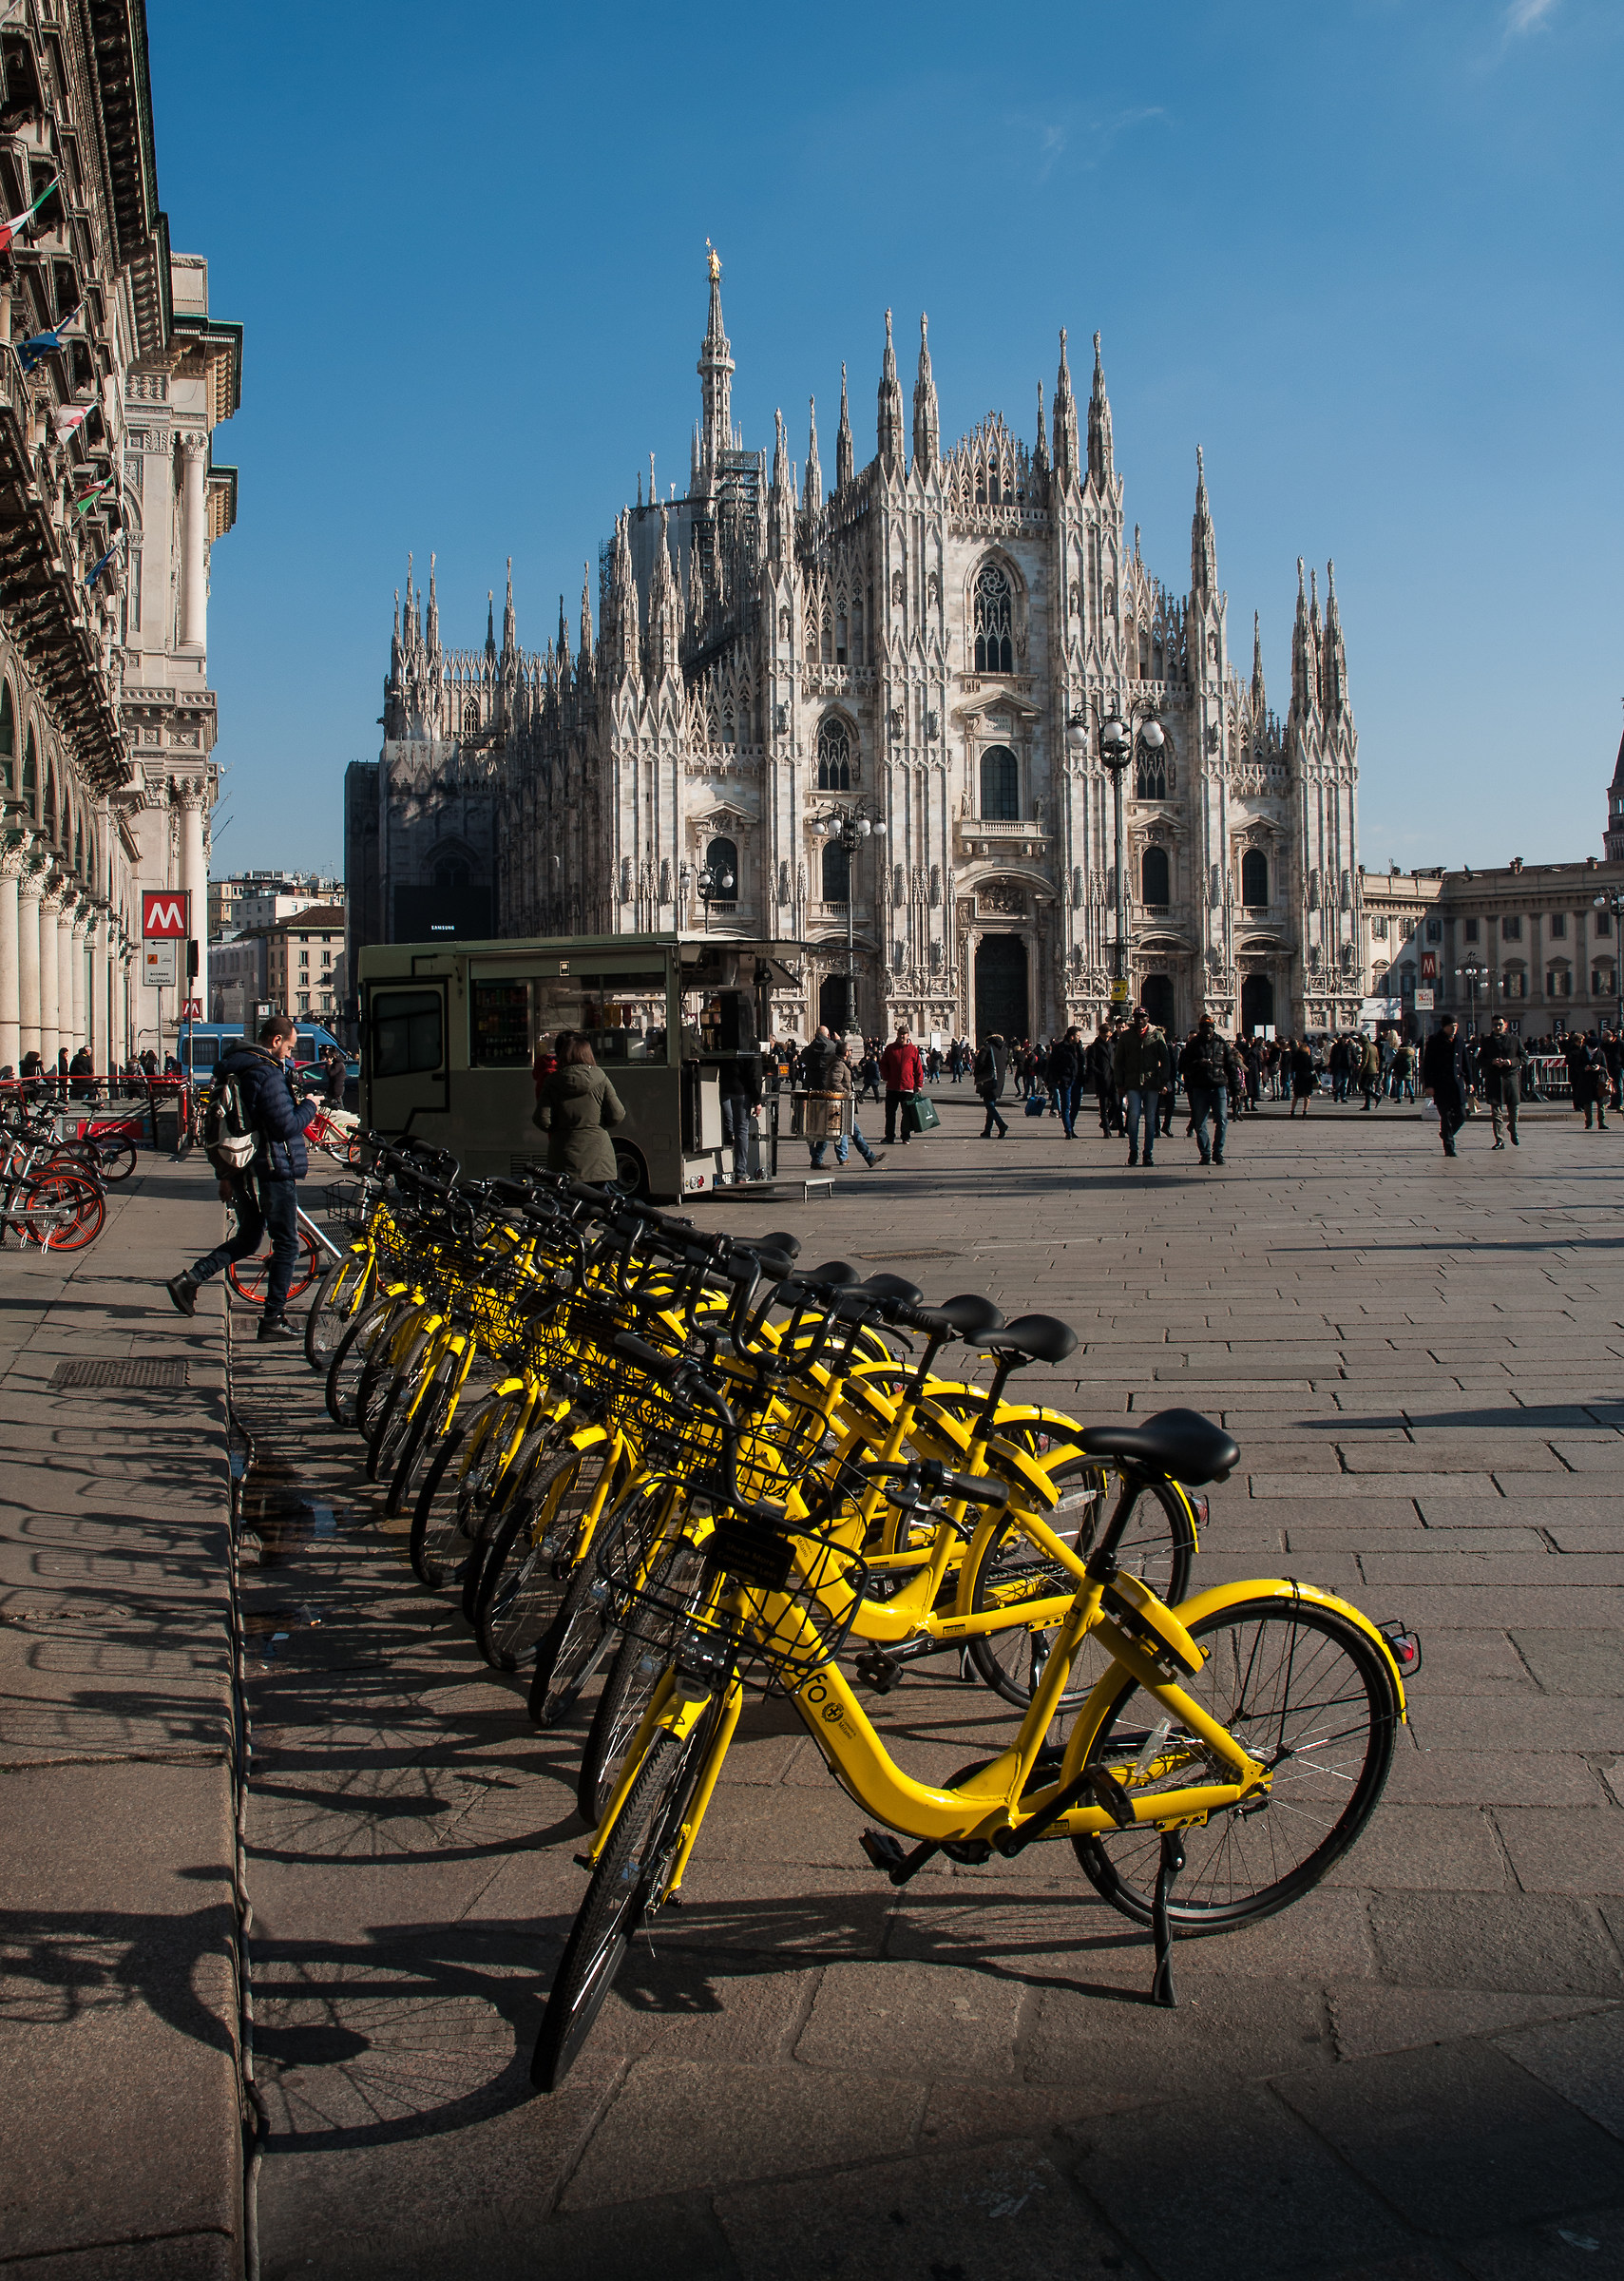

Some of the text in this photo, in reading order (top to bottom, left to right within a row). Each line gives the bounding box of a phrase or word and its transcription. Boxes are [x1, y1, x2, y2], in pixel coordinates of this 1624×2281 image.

[146, 902, 184, 929] M
[1423, 958, 1435, 974] M
[183, 1003, 200, 1014] M
[752, 1552, 776, 1567] More
[837, 1721, 852, 1740] Milano
